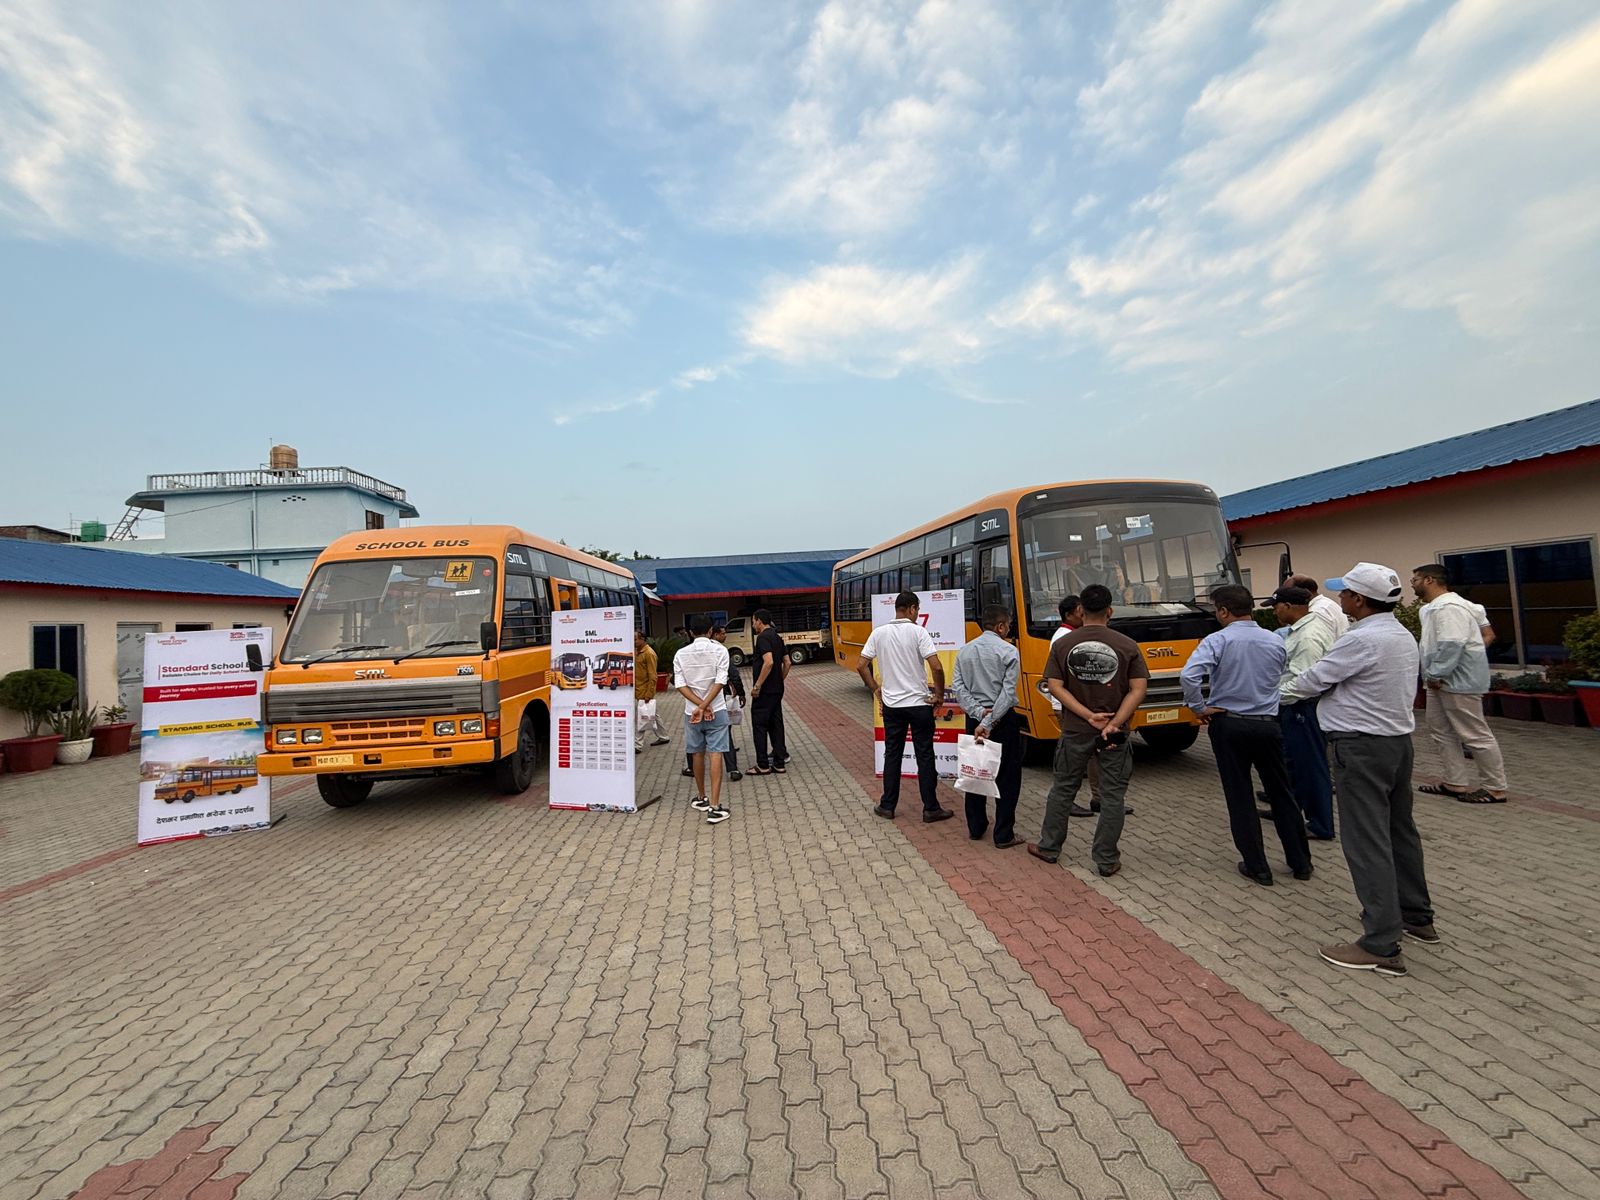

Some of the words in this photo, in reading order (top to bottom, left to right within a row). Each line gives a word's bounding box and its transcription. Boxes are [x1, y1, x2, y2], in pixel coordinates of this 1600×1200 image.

[981, 518, 1000, 532] SML
[355, 541, 426, 550] SCHOOL
[433, 539, 470, 547] BUS
[507, 552, 527, 565] SML
[1146, 647, 1180, 659] SML
[162, 664, 209, 673] Standard
[211, 661, 244, 670] School
[354, 669, 391, 680] SML
[576, 700, 608, 708] Specifications
[163, 725, 203, 733] STANDARD
[156, 816, 178, 824] देशभर
